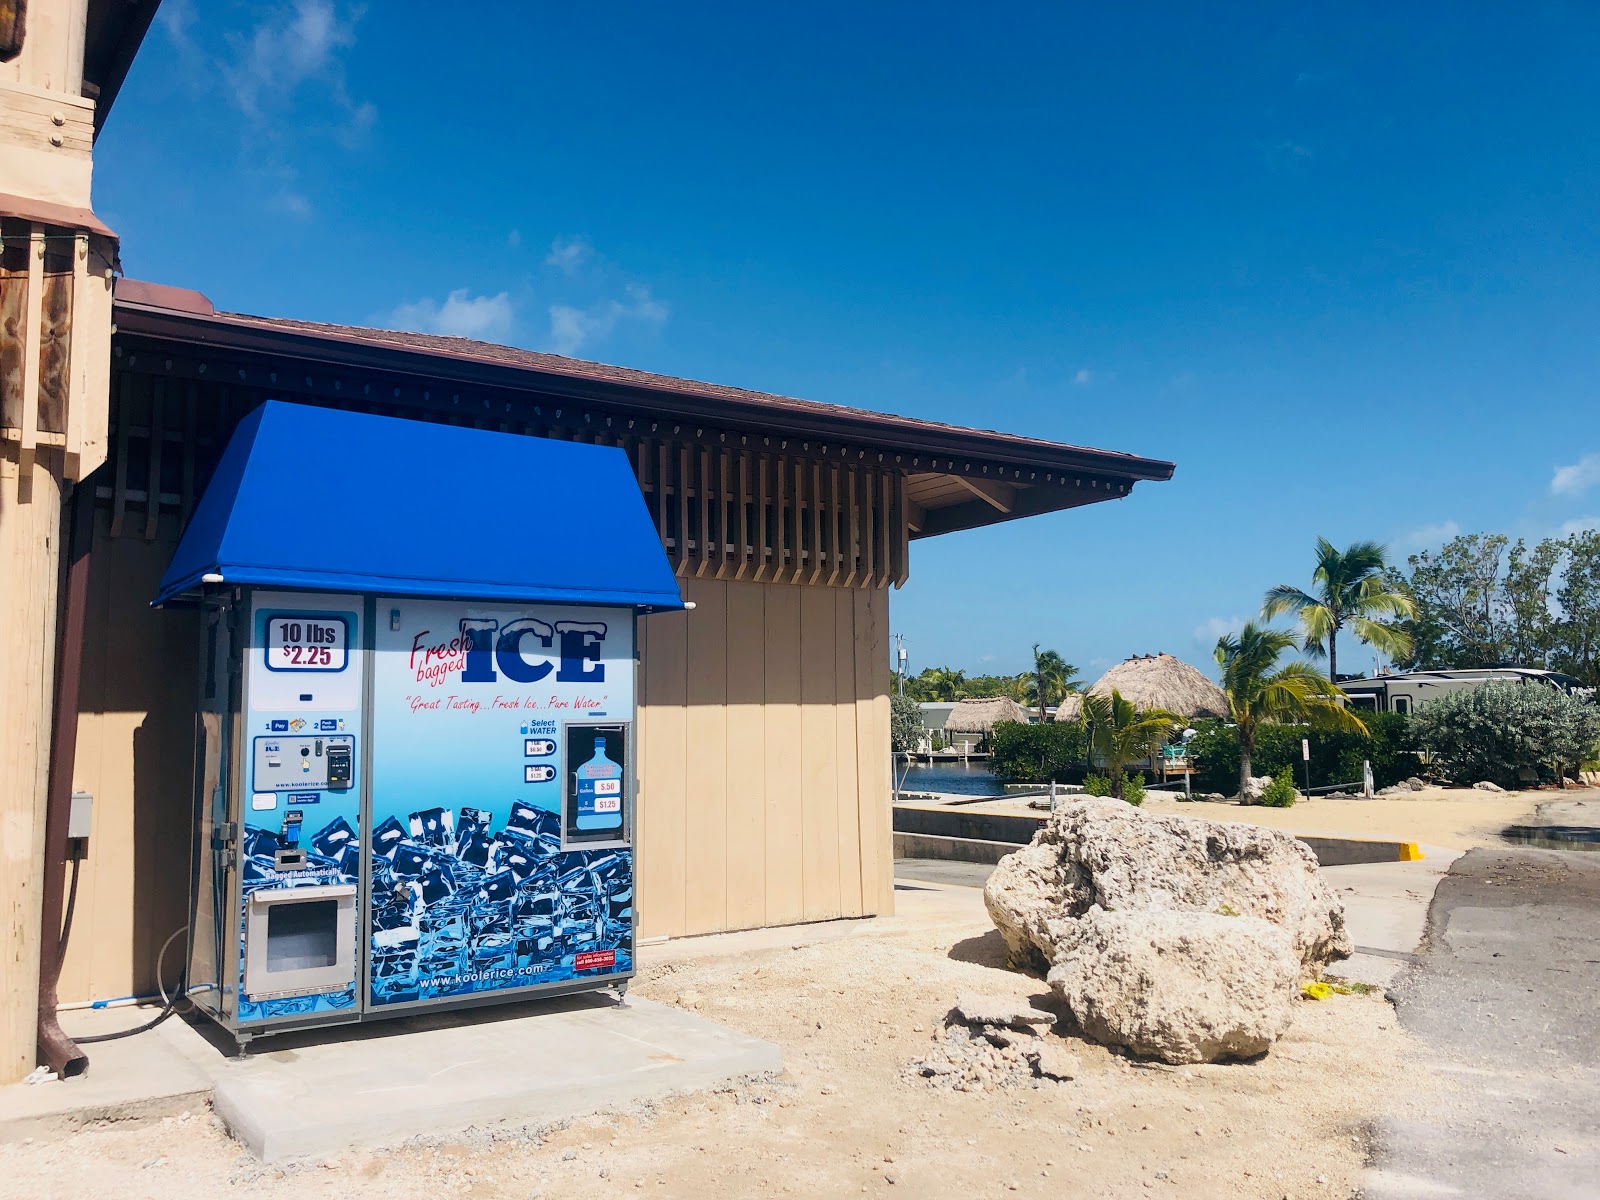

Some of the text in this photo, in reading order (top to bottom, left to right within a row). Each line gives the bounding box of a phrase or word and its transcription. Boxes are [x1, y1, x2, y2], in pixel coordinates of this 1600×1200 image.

[280, 623, 336, 643] 10 lbs
[283, 645, 332, 665] $2.25
[410, 623, 473, 669] Fresh
[459, 618, 607, 683] ICE
[416, 652, 465, 687] bagged
[530, 727, 557, 735] WATER
[531, 719, 555, 727] Select
[600, 782, 615, 791] $.50
[599, 800, 617, 809] $1.25
[265, 866, 341, 881] Bagged Automatically
[420, 964, 544, 988] www.koolerice.com
